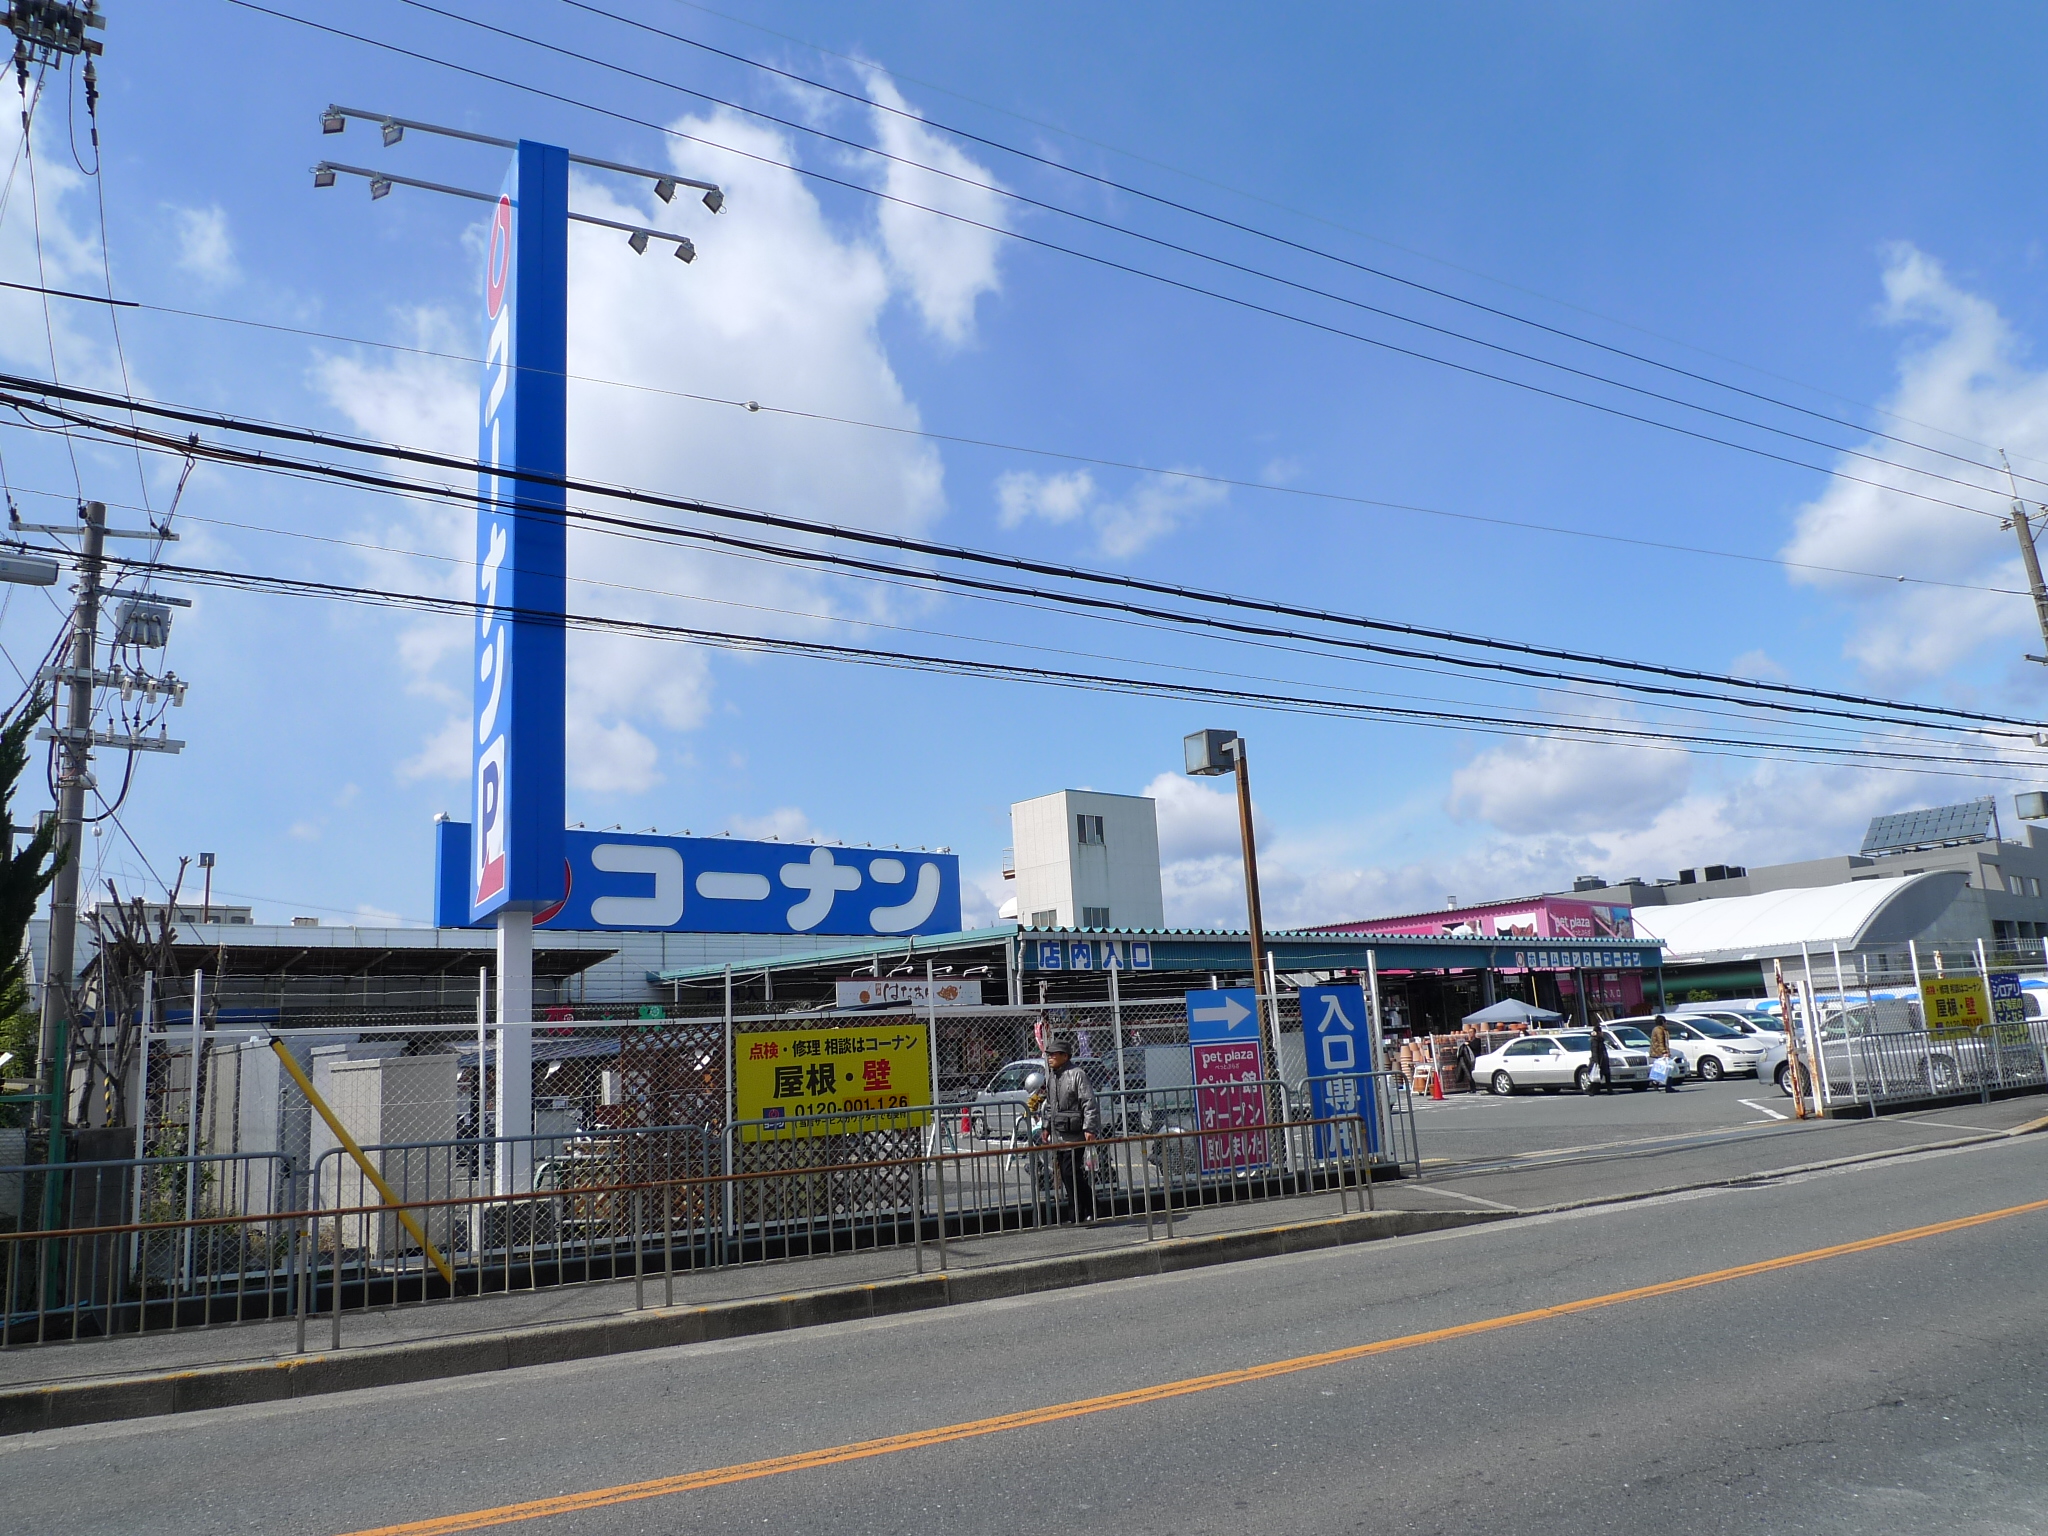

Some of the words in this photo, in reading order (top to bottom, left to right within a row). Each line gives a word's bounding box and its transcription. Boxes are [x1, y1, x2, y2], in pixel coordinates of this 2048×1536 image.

[480, 303, 509, 745] コーナン
[482, 760, 499, 869] P
[591, 843, 941, 933] コーナン
[1555, 916, 1569, 933] pet
[1570, 917, 1591, 930] plaza
[1039, 940, 1151, 968] 店内入口
[1527, 952, 1641, 966] ホームセンターコーナン
[1992, 983, 2020, 997] シロアリ
[1936, 996, 1977, 1018] 屋根・壁
[749, 1039, 821, 1060] 点検・修理
[824, 1034, 918, 1056] 相談はコーナン
[1202, 1050, 1222, 1069] pet
[1224, 1047, 1254, 1064] plaza
[773, 1058, 892, 1099] 屋根・壁
[1200, 1070, 1258, 1097] ペット館
[1317, 994, 1361, 1153] 入口専用
[1204, 1102, 1261, 1128] オープン
